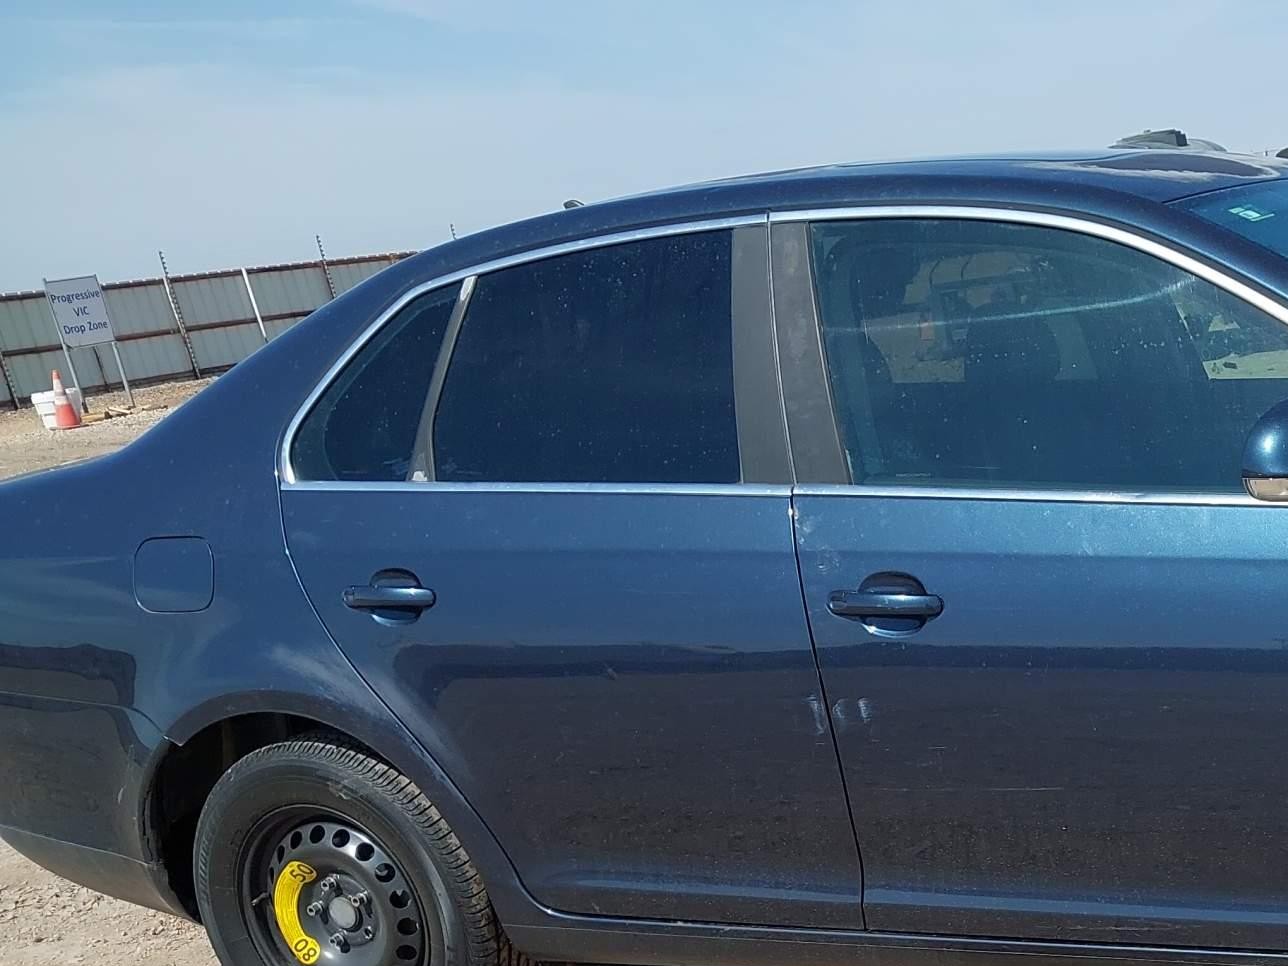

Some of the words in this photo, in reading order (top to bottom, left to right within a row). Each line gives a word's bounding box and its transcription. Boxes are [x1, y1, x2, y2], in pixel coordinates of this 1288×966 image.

[50, 288, 100, 304] Progressive
[72, 306, 89, 317] VIC
[63, 324, 86, 335] Drop
[87, 320, 108, 331] Zone
[289, 863, 315, 883] 50
[294, 938, 318, 962] 80
